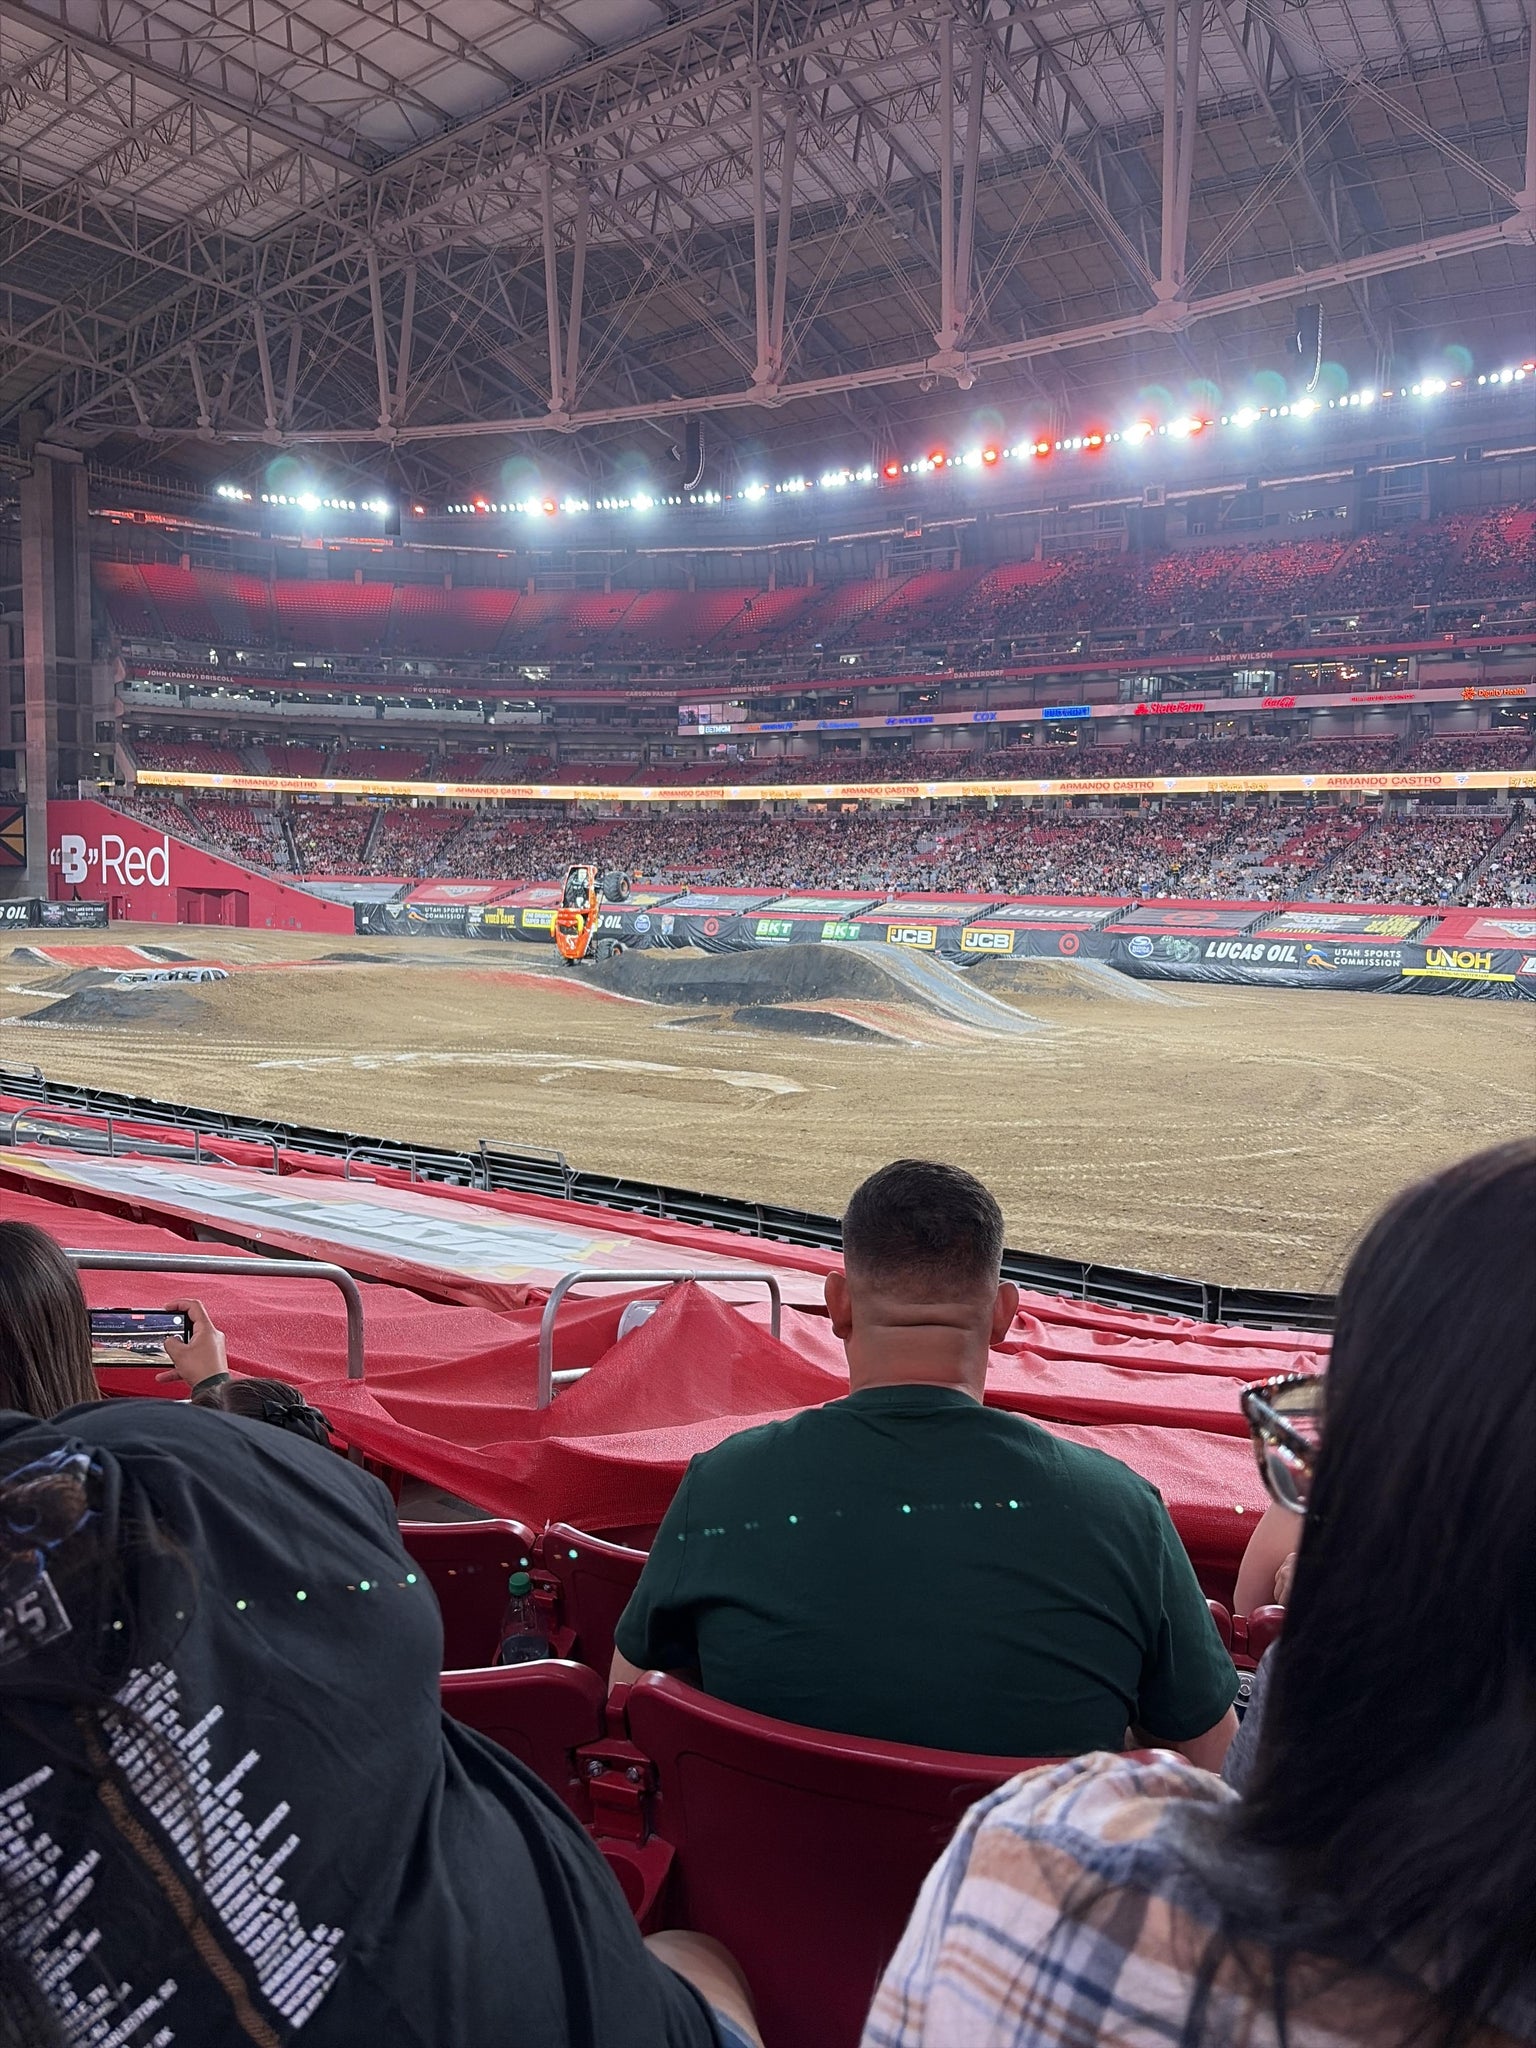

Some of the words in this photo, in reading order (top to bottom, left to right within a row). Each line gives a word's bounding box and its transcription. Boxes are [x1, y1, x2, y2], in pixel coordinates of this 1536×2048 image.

[1235, 652, 1273, 661] WILSON
[147, 670, 167, 678] JOHN
[200, 674, 235, 683] DRISCOLL
[968, 670, 1004, 678] DIERDORF
[1503, 688, 1527, 696] Health
[974, 712, 997, 722] COX
[1059, 782, 1111, 791] ARMANDO
[1113, 781, 1154, 790] CASTRO
[1327, 777, 1388, 786] ARMANDO
[1391, 776, 1442, 785] CASTRO
[841, 787, 881, 795] ARMANDO
[883, 786, 919, 794] CASTRO
[757, 920, 792, 934] BKT
[823, 923, 860, 937] BKT
[891, 929, 932, 944] JCB
[965, 933, 1010, 948] JCB
[1205, 941, 1264, 962] LUCAS
[1334, 948, 1361, 958] UTAH
[1364, 949, 1402, 958] SPORTS
[1334, 957, 1401, 967] COMMISSION
[1426, 947, 1492, 970] UNOH
[233, 1905, 274, 1947] TAMPA,
[242, 1913, 287, 1959] TOLEDO,
[277, 1969, 325, 2019] WICHITA,
